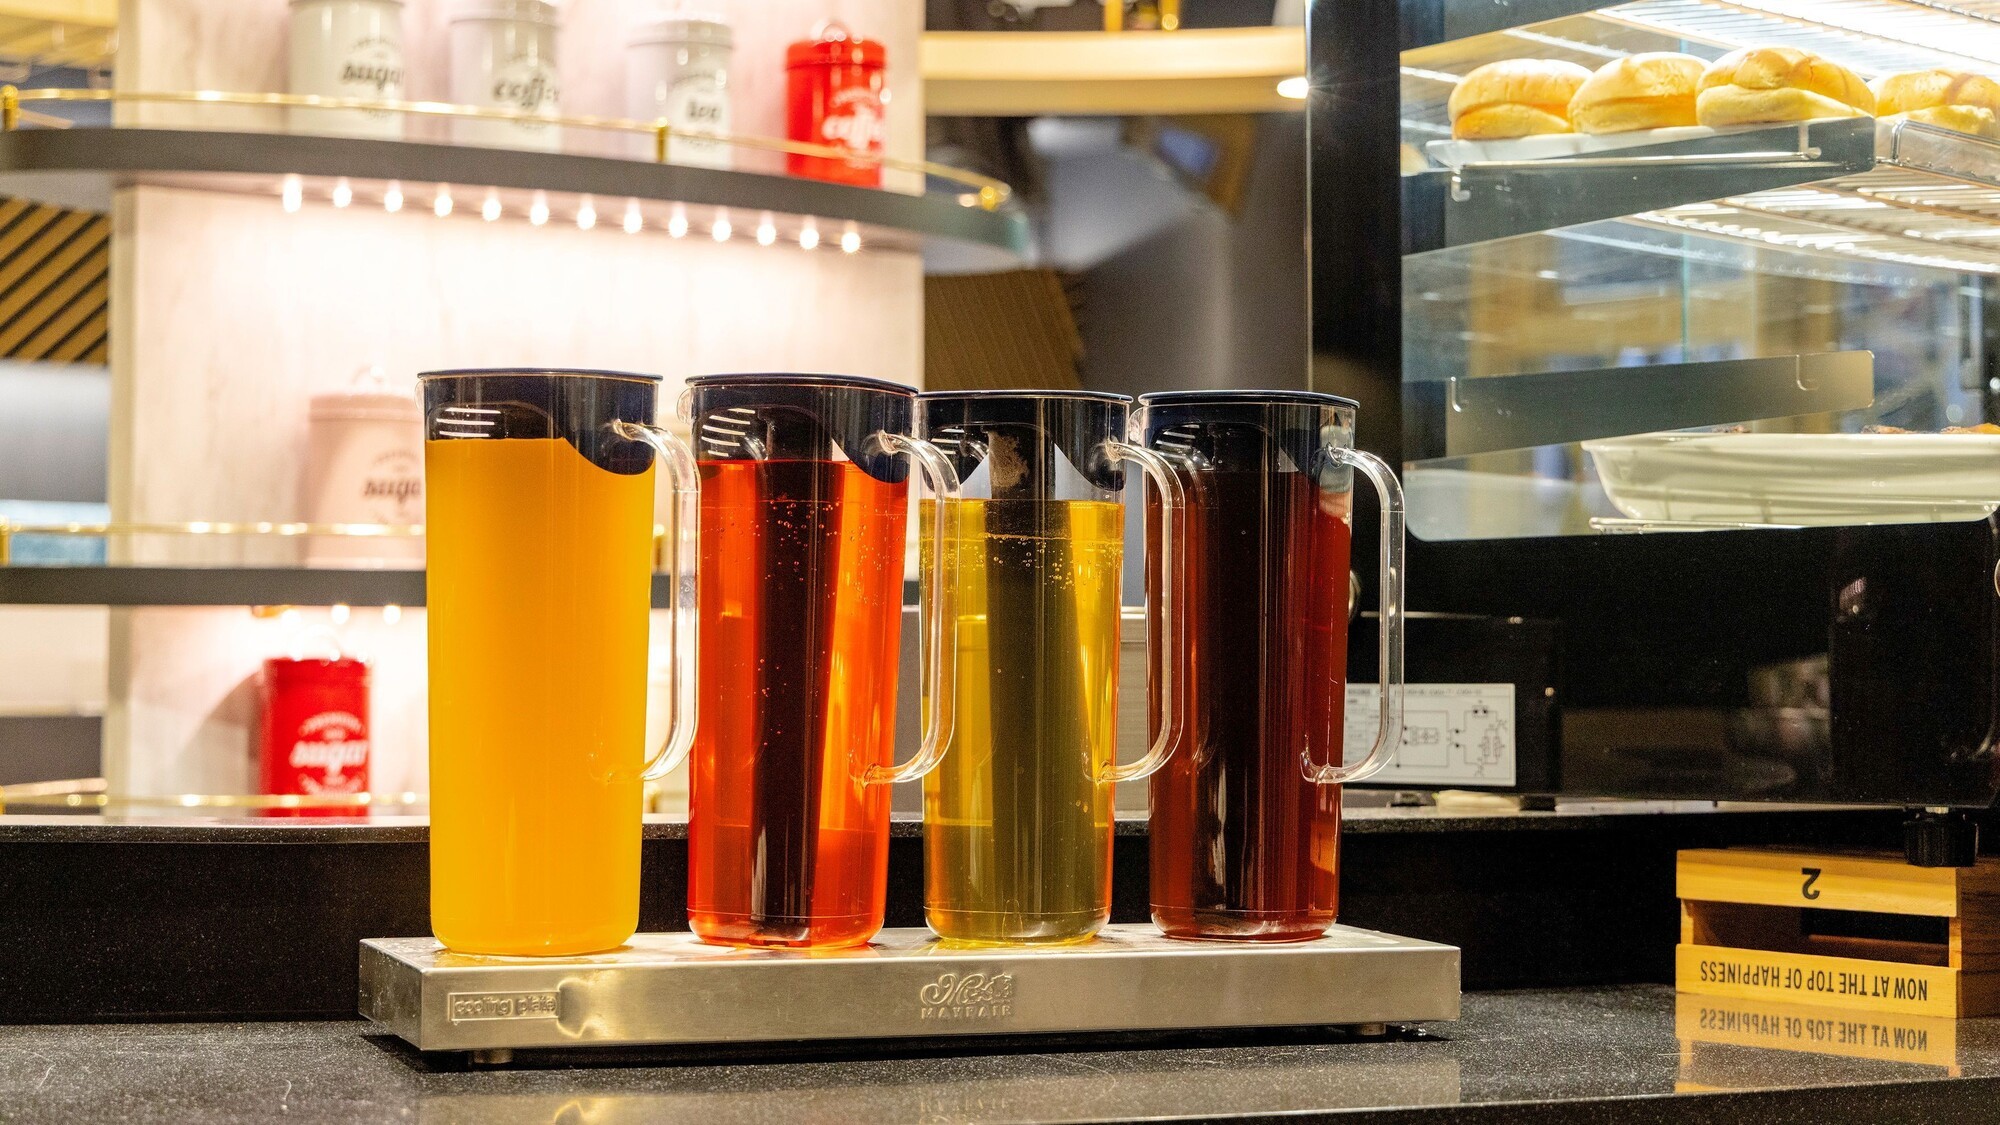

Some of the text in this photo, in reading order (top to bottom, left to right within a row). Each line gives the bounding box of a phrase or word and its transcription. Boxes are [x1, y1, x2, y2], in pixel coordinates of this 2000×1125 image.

[1801, 867, 1821, 900] 2
[1700, 960, 1928, 1001] NOW AT THE TOP OF HAPPINESS
